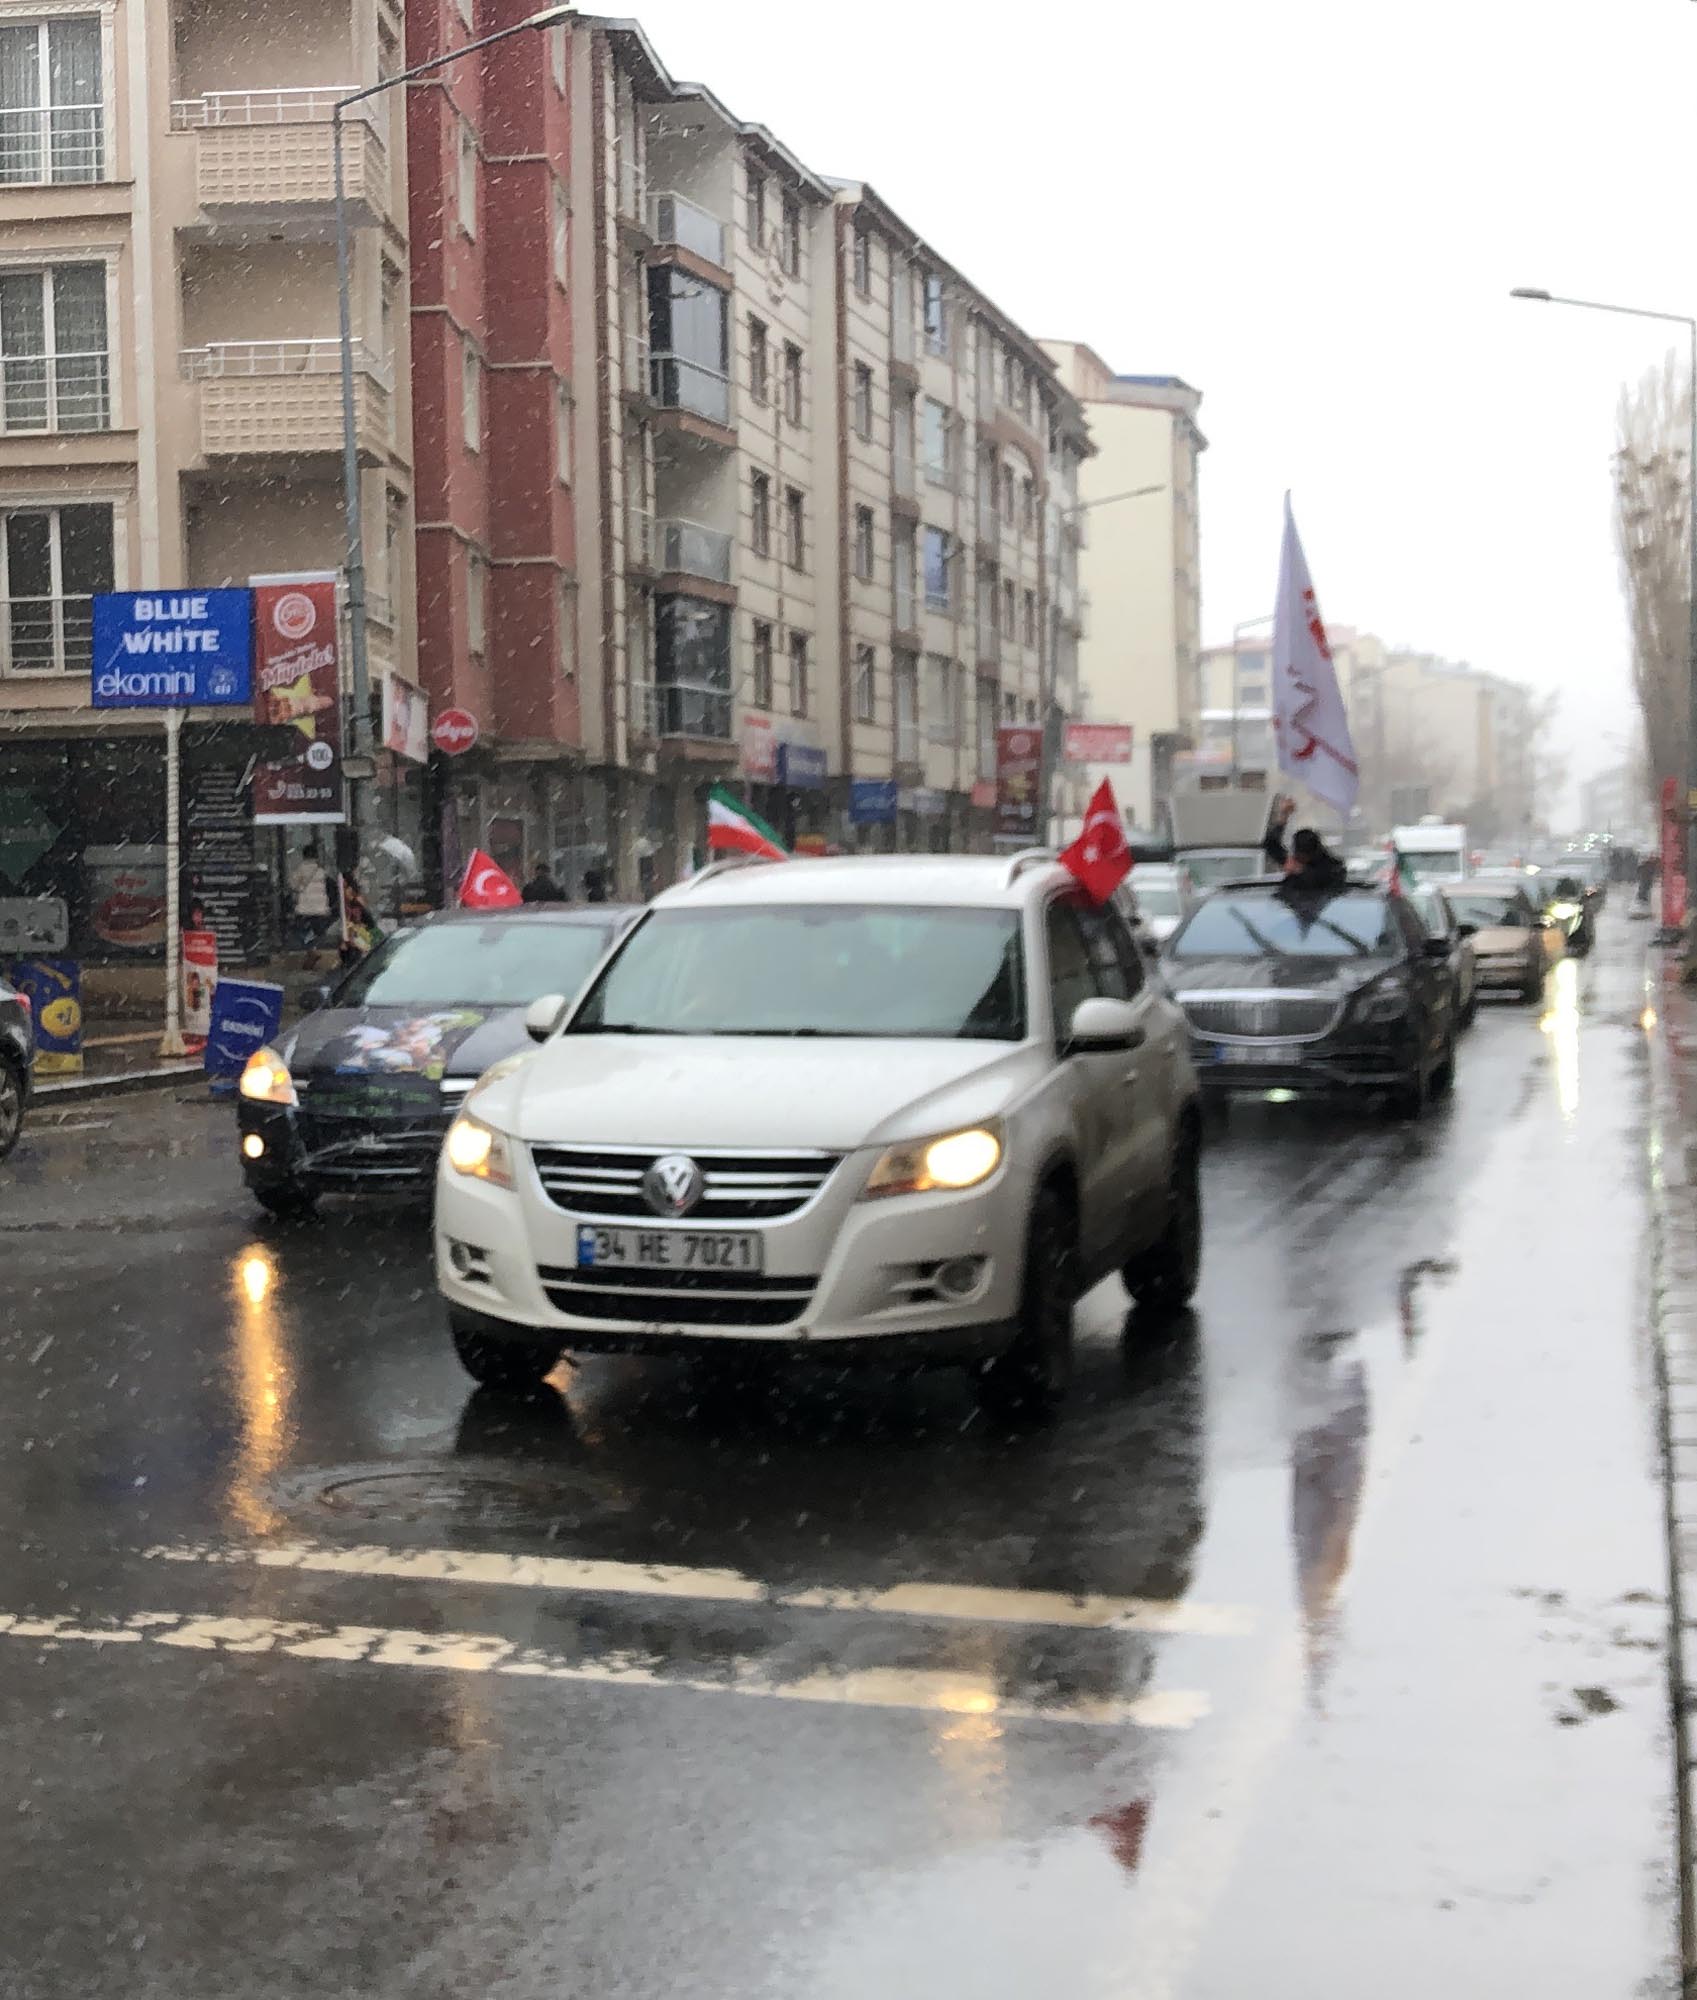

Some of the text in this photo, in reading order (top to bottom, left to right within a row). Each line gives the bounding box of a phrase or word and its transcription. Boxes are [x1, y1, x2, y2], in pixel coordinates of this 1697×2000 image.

[134, 597, 209, 621] BLUE
[99, 664, 196, 697] ekomini
[595, 1230, 751, 1266] 34 HE 7021
